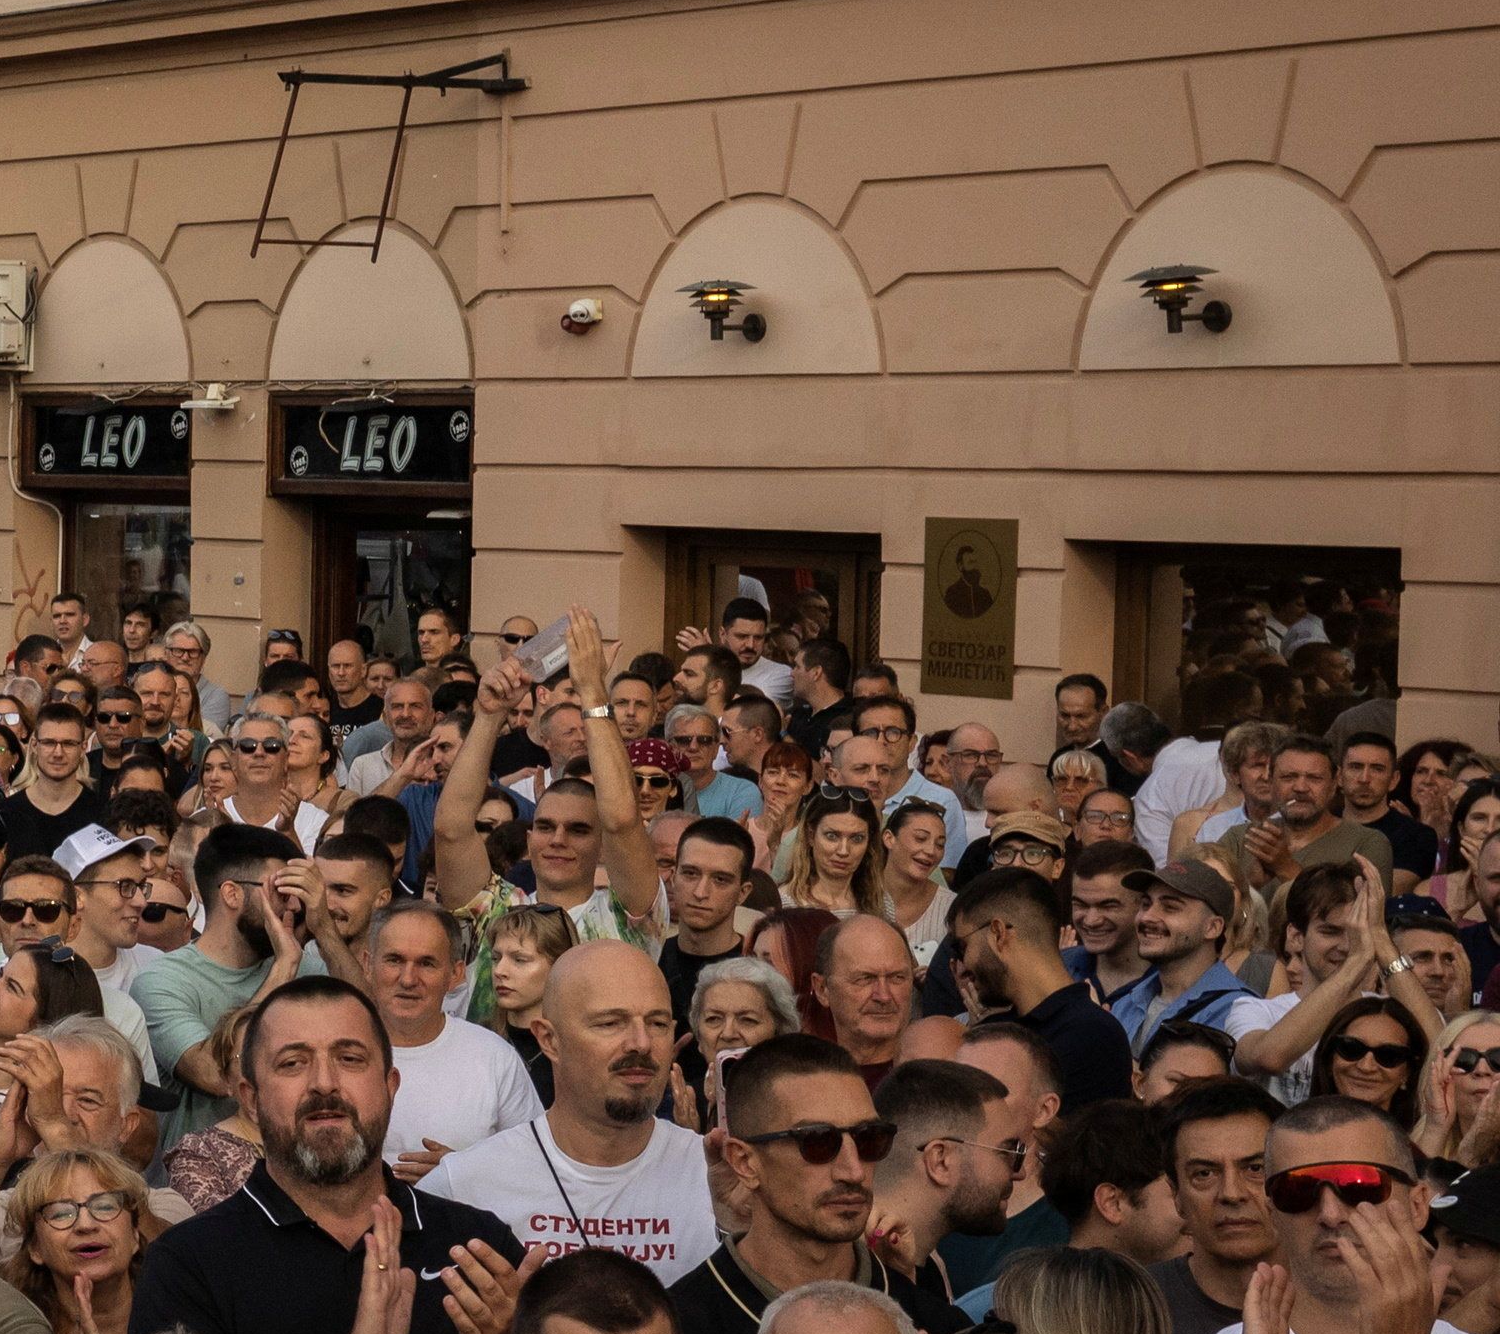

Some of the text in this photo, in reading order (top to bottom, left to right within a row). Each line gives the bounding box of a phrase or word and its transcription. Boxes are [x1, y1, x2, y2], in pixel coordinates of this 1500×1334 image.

[81, 415, 147, 467] LEO
[340, 415, 418, 473] LEO
[928, 640, 1006, 661] СВЕТОЗАР
[927, 659, 1006, 682] МИЛЕТИЋ
[529, 1214, 670, 1239] СТУДЕНТИ
